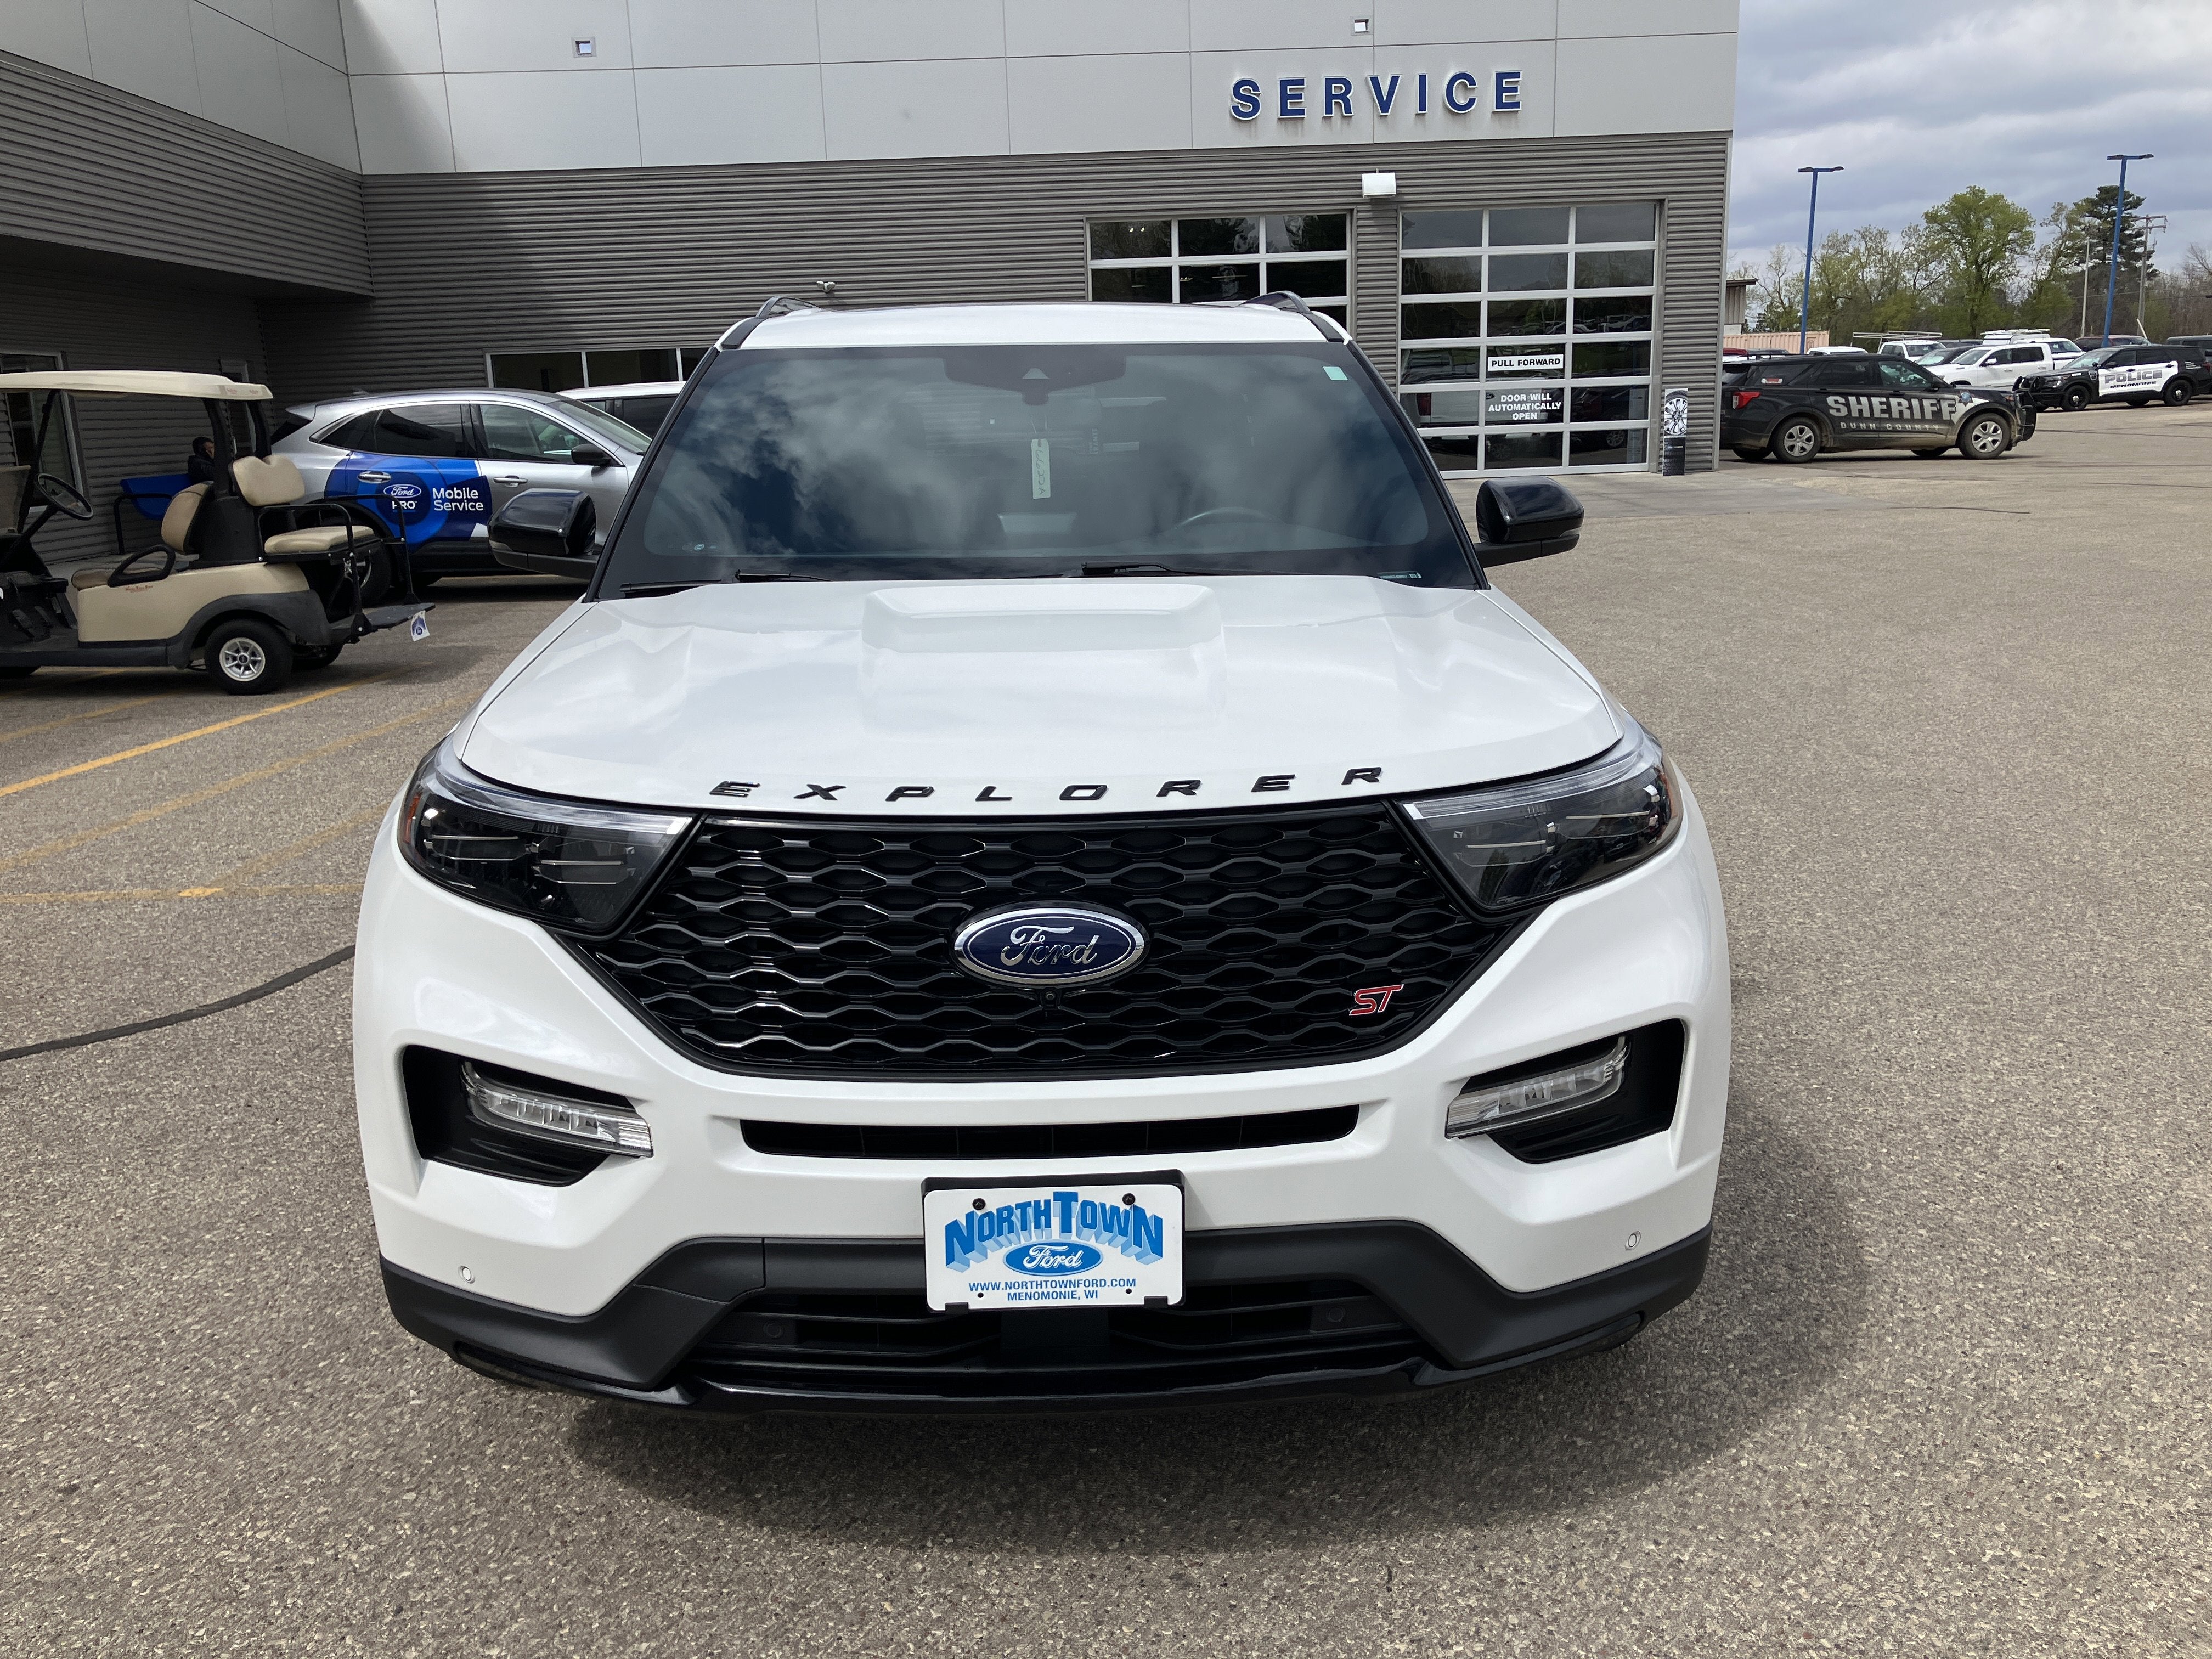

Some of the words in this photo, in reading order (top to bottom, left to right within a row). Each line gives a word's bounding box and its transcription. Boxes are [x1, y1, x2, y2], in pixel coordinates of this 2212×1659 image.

[1231, 70, 1522, 121] SERVICE
[2104, 370, 2163, 384] POLICE
[1500, 394, 1527, 402] DOOR
[1488, 402, 1562, 411] AUTOMATICALLY
[1826, 396, 1956, 420] SHERIFF
[1512, 412, 1537, 420] OPEN
[1840, 422, 1876, 430] DUNN
[391, 486, 414, 496] Ford
[432, 487, 479, 499] Mobile
[433, 500, 484, 511] Service
[709, 766, 1383, 802] EXPLORER
[1000, 924, 1099, 966] Ford
[1348, 984, 1404, 1016] ST
[1023, 1245, 1083, 1269] Ford
[969, 1278, 1136, 1292] WWW.NORTHTOWNFORD.COM
[1007, 1290, 1081, 1301] MENOMONIE,
[1084, 1290, 1098, 1299] WI
